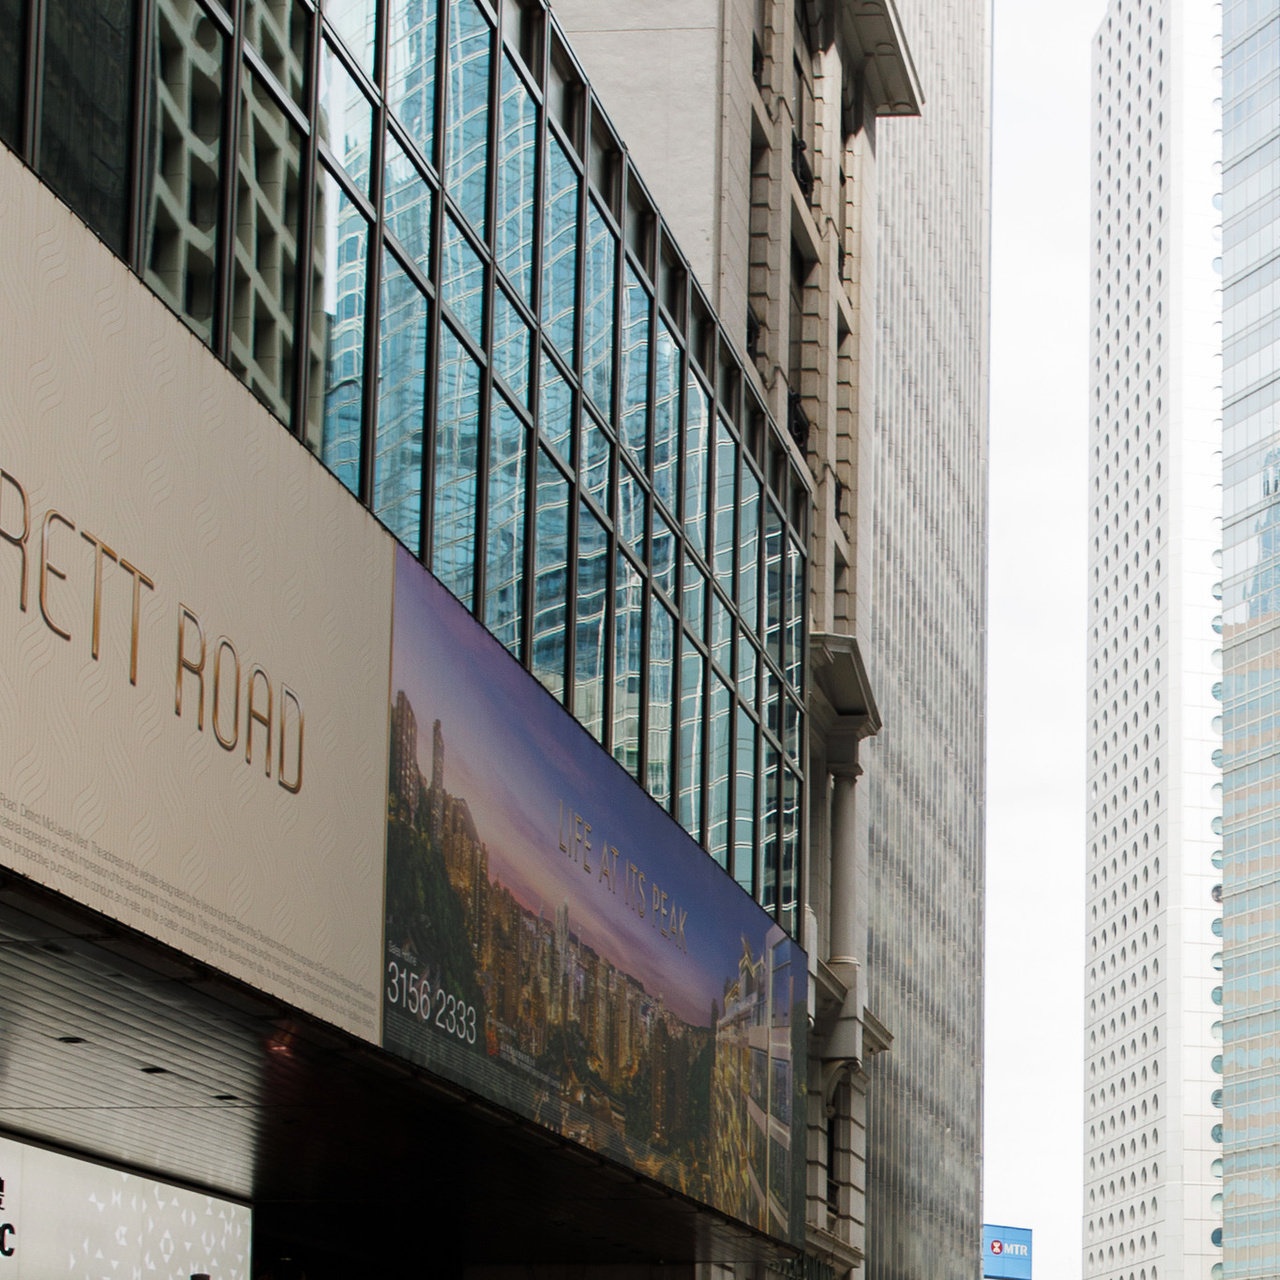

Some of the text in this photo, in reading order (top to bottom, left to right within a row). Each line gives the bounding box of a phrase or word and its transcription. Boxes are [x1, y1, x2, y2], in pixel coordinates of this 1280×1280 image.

[175, 602, 304, 794] ROAD
[558, 799, 689, 954] LIFE AT ITS PEAK
[387, 961, 431, 1020] 3156
[435, 989, 477, 1044] 2333
[1004, 1243, 1028, 1256] MTR
